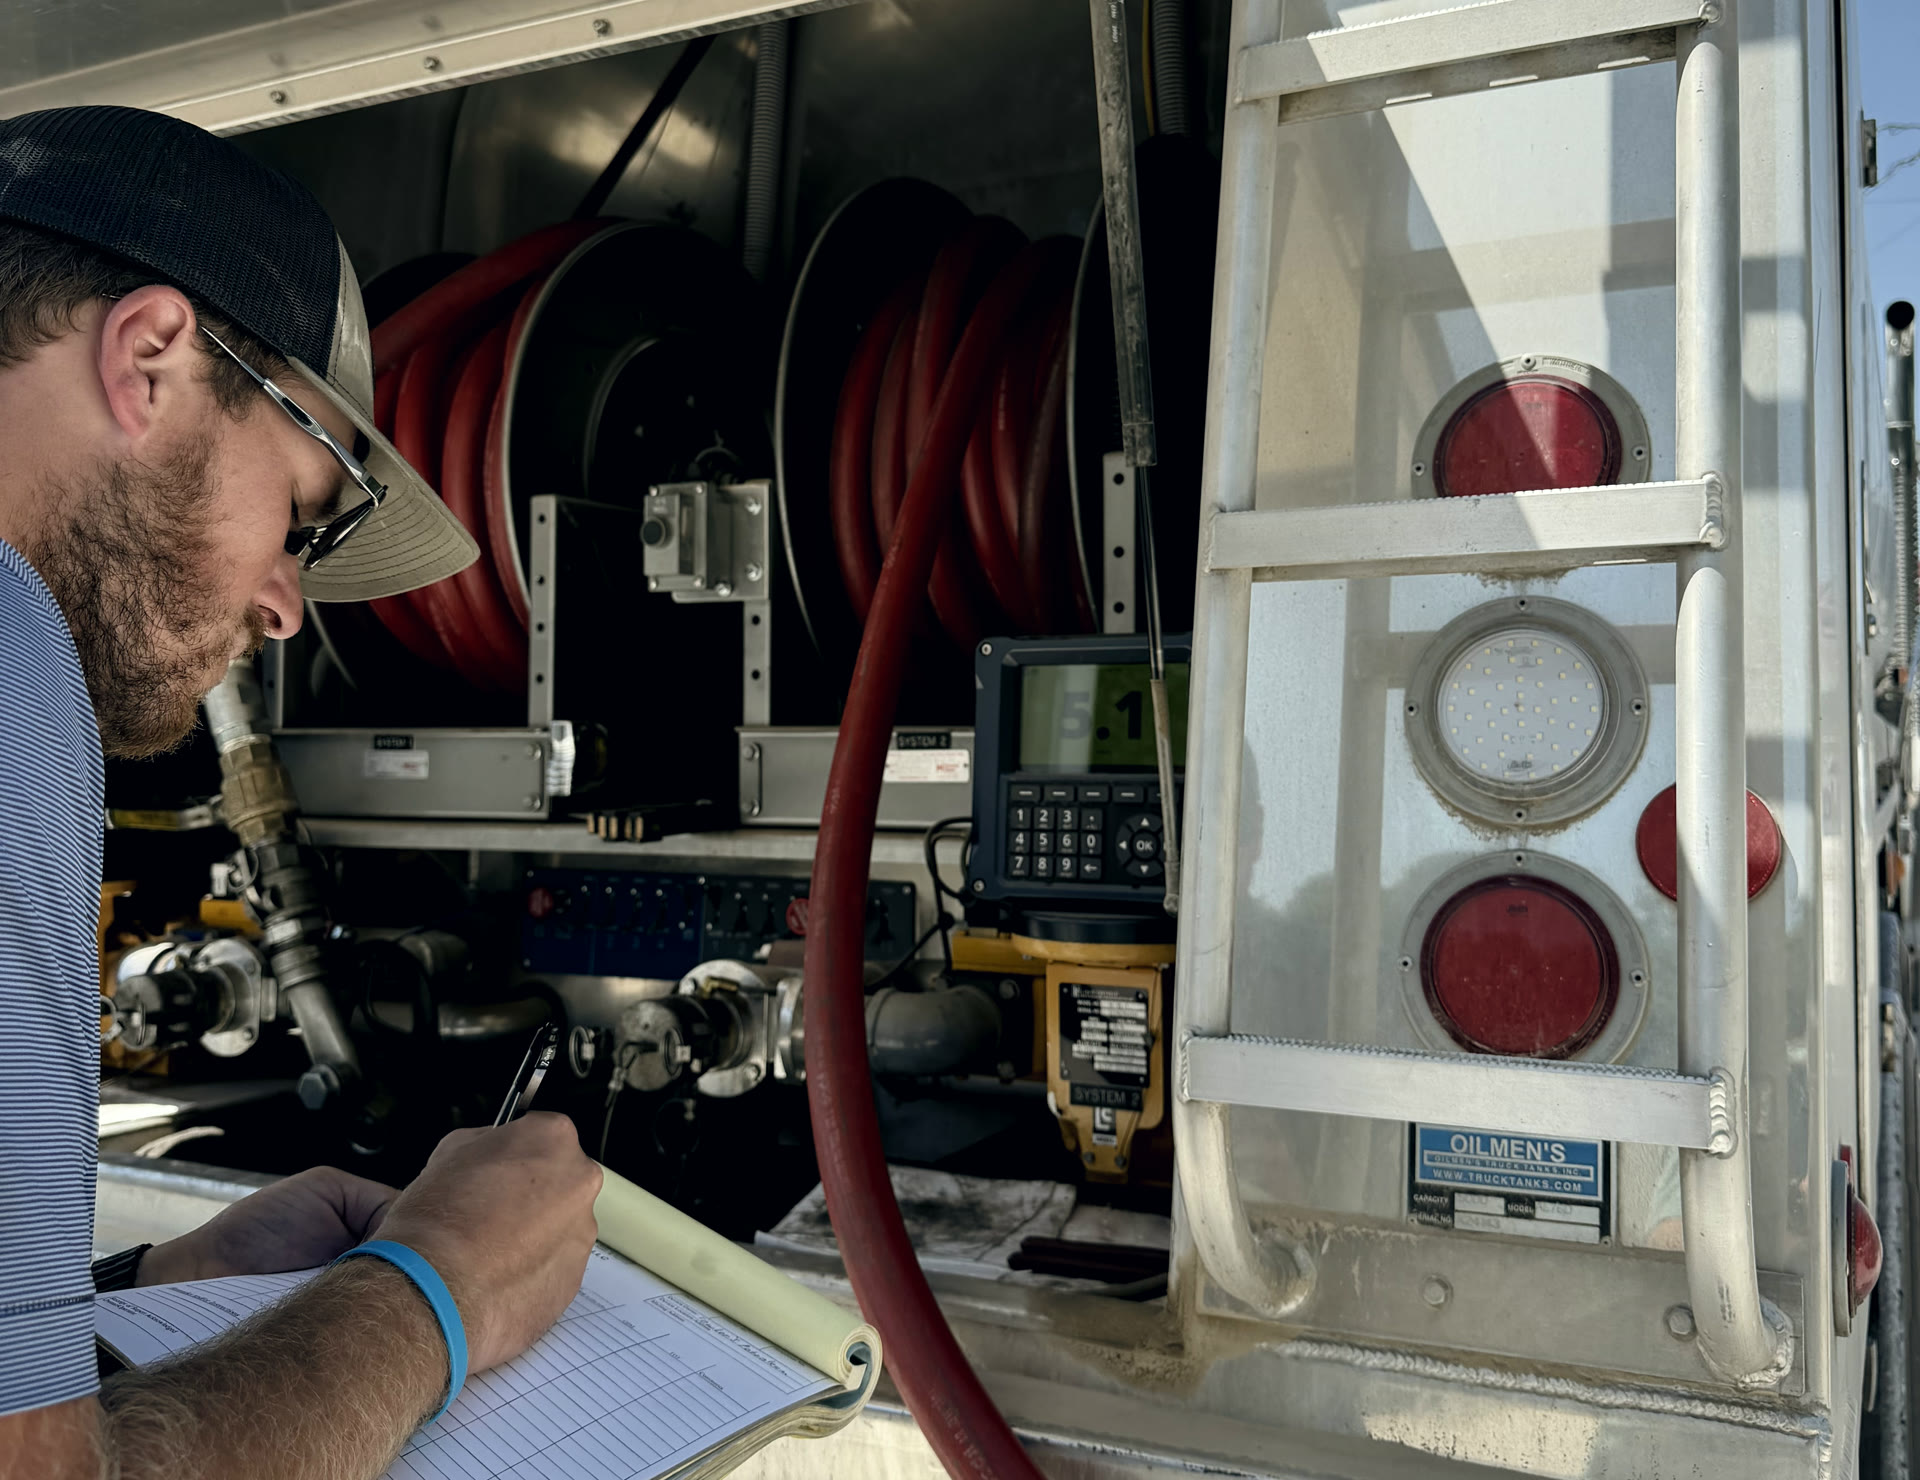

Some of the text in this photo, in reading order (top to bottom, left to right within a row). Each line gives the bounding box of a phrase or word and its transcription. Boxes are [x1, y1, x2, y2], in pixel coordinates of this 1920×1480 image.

[897, 735, 937, 748] SYSTEM
[1016, 809, 1072, 823] 1 2 3
[1015, 832, 1096, 847] 4 5 6 0
[1135, 840, 1153, 851] OK
[1015, 856, 1071, 871] 7 8 9
[1074, 1085, 1127, 1105] SYSTEM
[1450, 1133, 1567, 1164] OILMEN'S
[1434, 1154, 1481, 1168] OILMEN'S
[1484, 1159, 1520, 1172] TRUCK
[1432, 1169, 1582, 1193] WWW.TRUCKTANKS.COM
[1413, 1193, 1449, 1205] CAPACITY
[1507, 1203, 1535, 1214] MODEL
